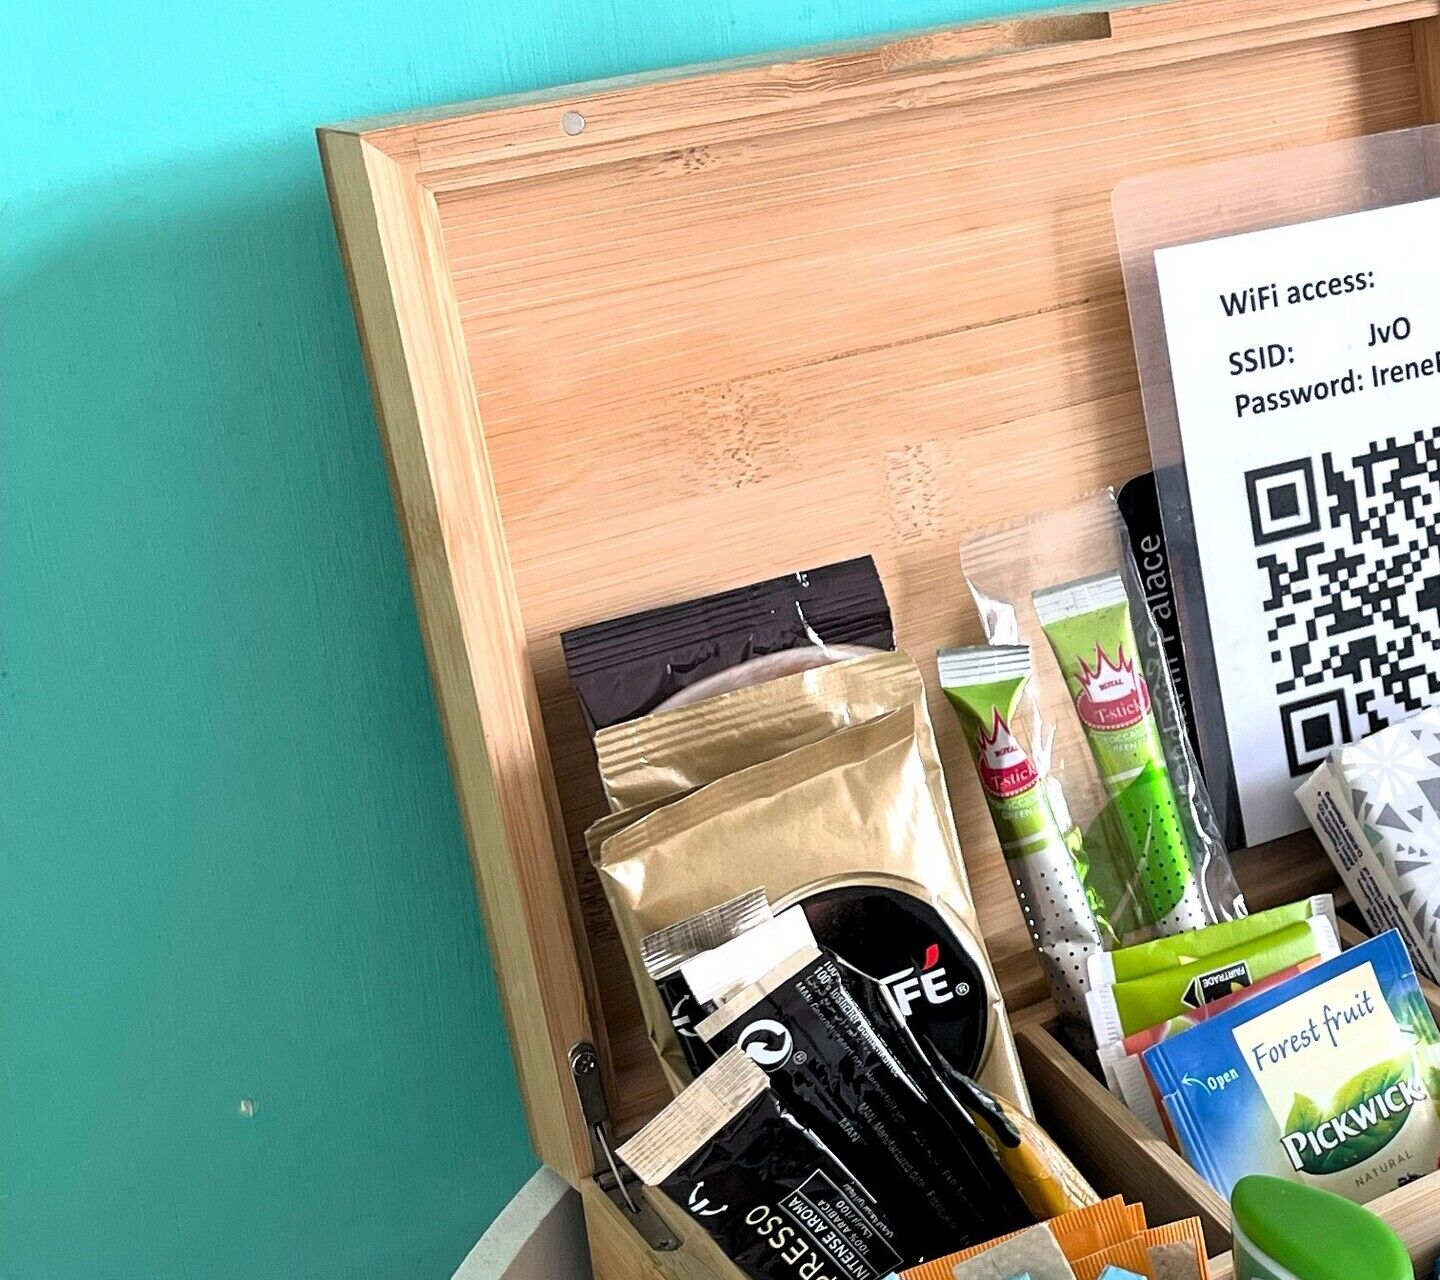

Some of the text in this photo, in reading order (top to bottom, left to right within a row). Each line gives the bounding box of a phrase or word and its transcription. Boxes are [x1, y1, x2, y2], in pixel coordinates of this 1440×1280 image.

[1220, 272, 1374, 316] WiFi access:
[1229, 317, 1410, 375] SSID: JvO
[1236, 369, 1363, 417] Password:
[1201, 965, 1246, 988] FAIRTRADE
[1251, 989, 1375, 1071] Forest fruit
[1206, 1067, 1239, 1092] Open
[1280, 1078, 1428, 1172] PICKWICK
[1354, 1150, 1414, 1188] NATURAL
[788, 1195, 828, 1234] AROMA
[817, 1198, 851, 1234] ARABICA
[847, 1231, 871, 1255] 100%
